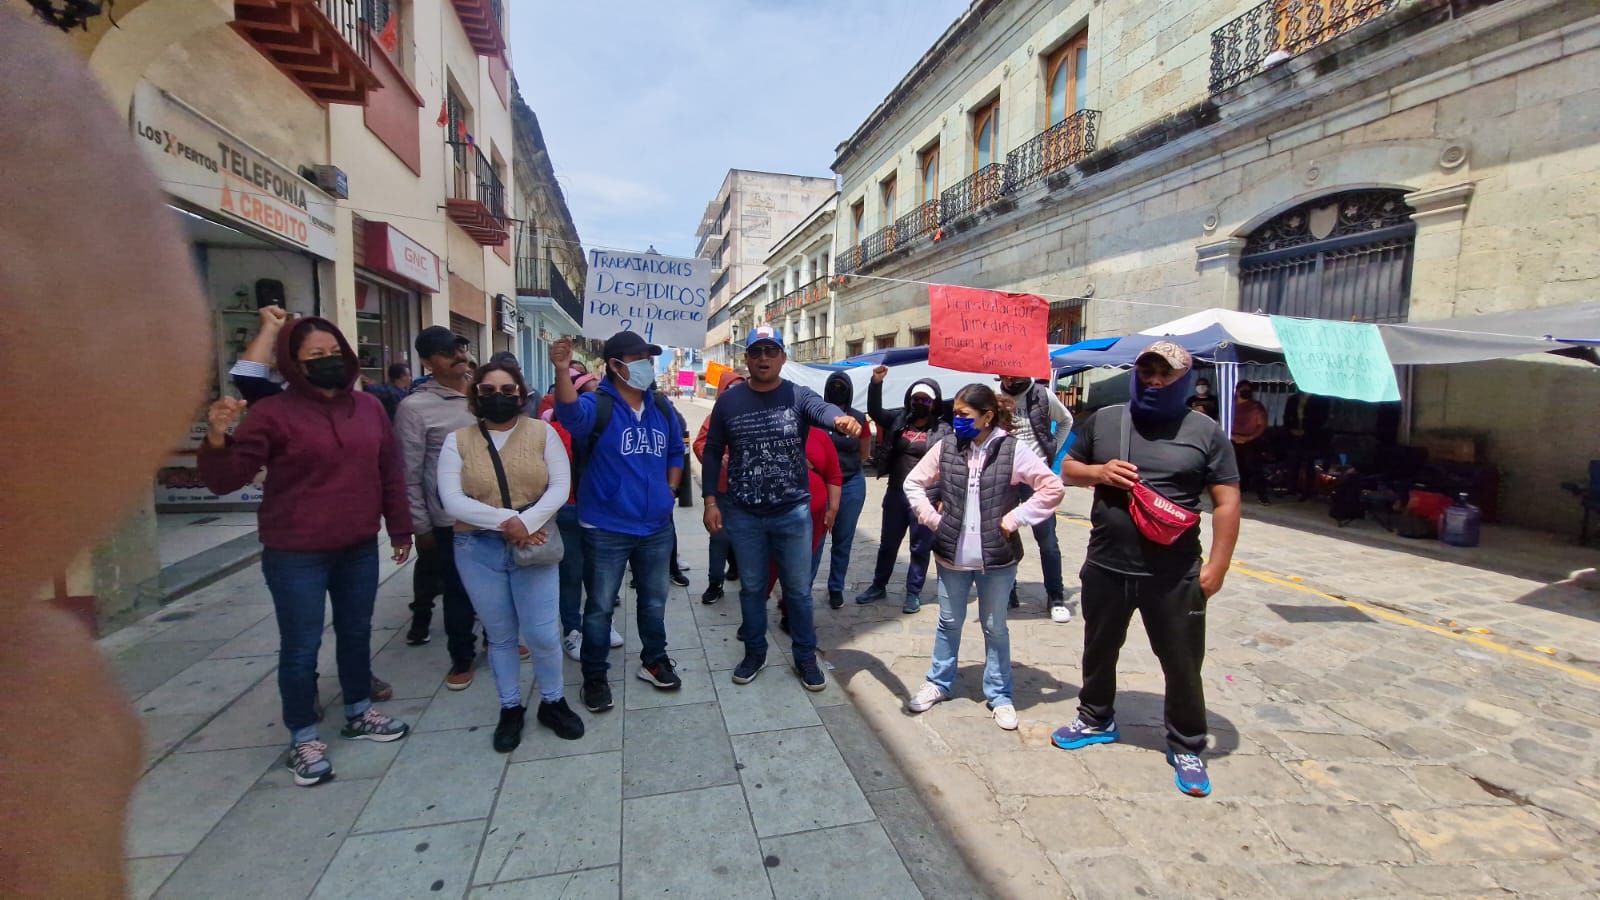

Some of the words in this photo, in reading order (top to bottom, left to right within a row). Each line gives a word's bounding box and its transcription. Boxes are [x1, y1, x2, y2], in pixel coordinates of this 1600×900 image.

[137, 120, 162, 145] LOS
[220, 184, 235, 211] A
[238, 192, 308, 242] CREDITO
[404, 246, 427, 271] GNC
[590, 300, 621, 317] POR
[629, 306, 641, 318] EL
[621, 427, 666, 457] GAP
[1153, 497, 1187, 521] Wilson
